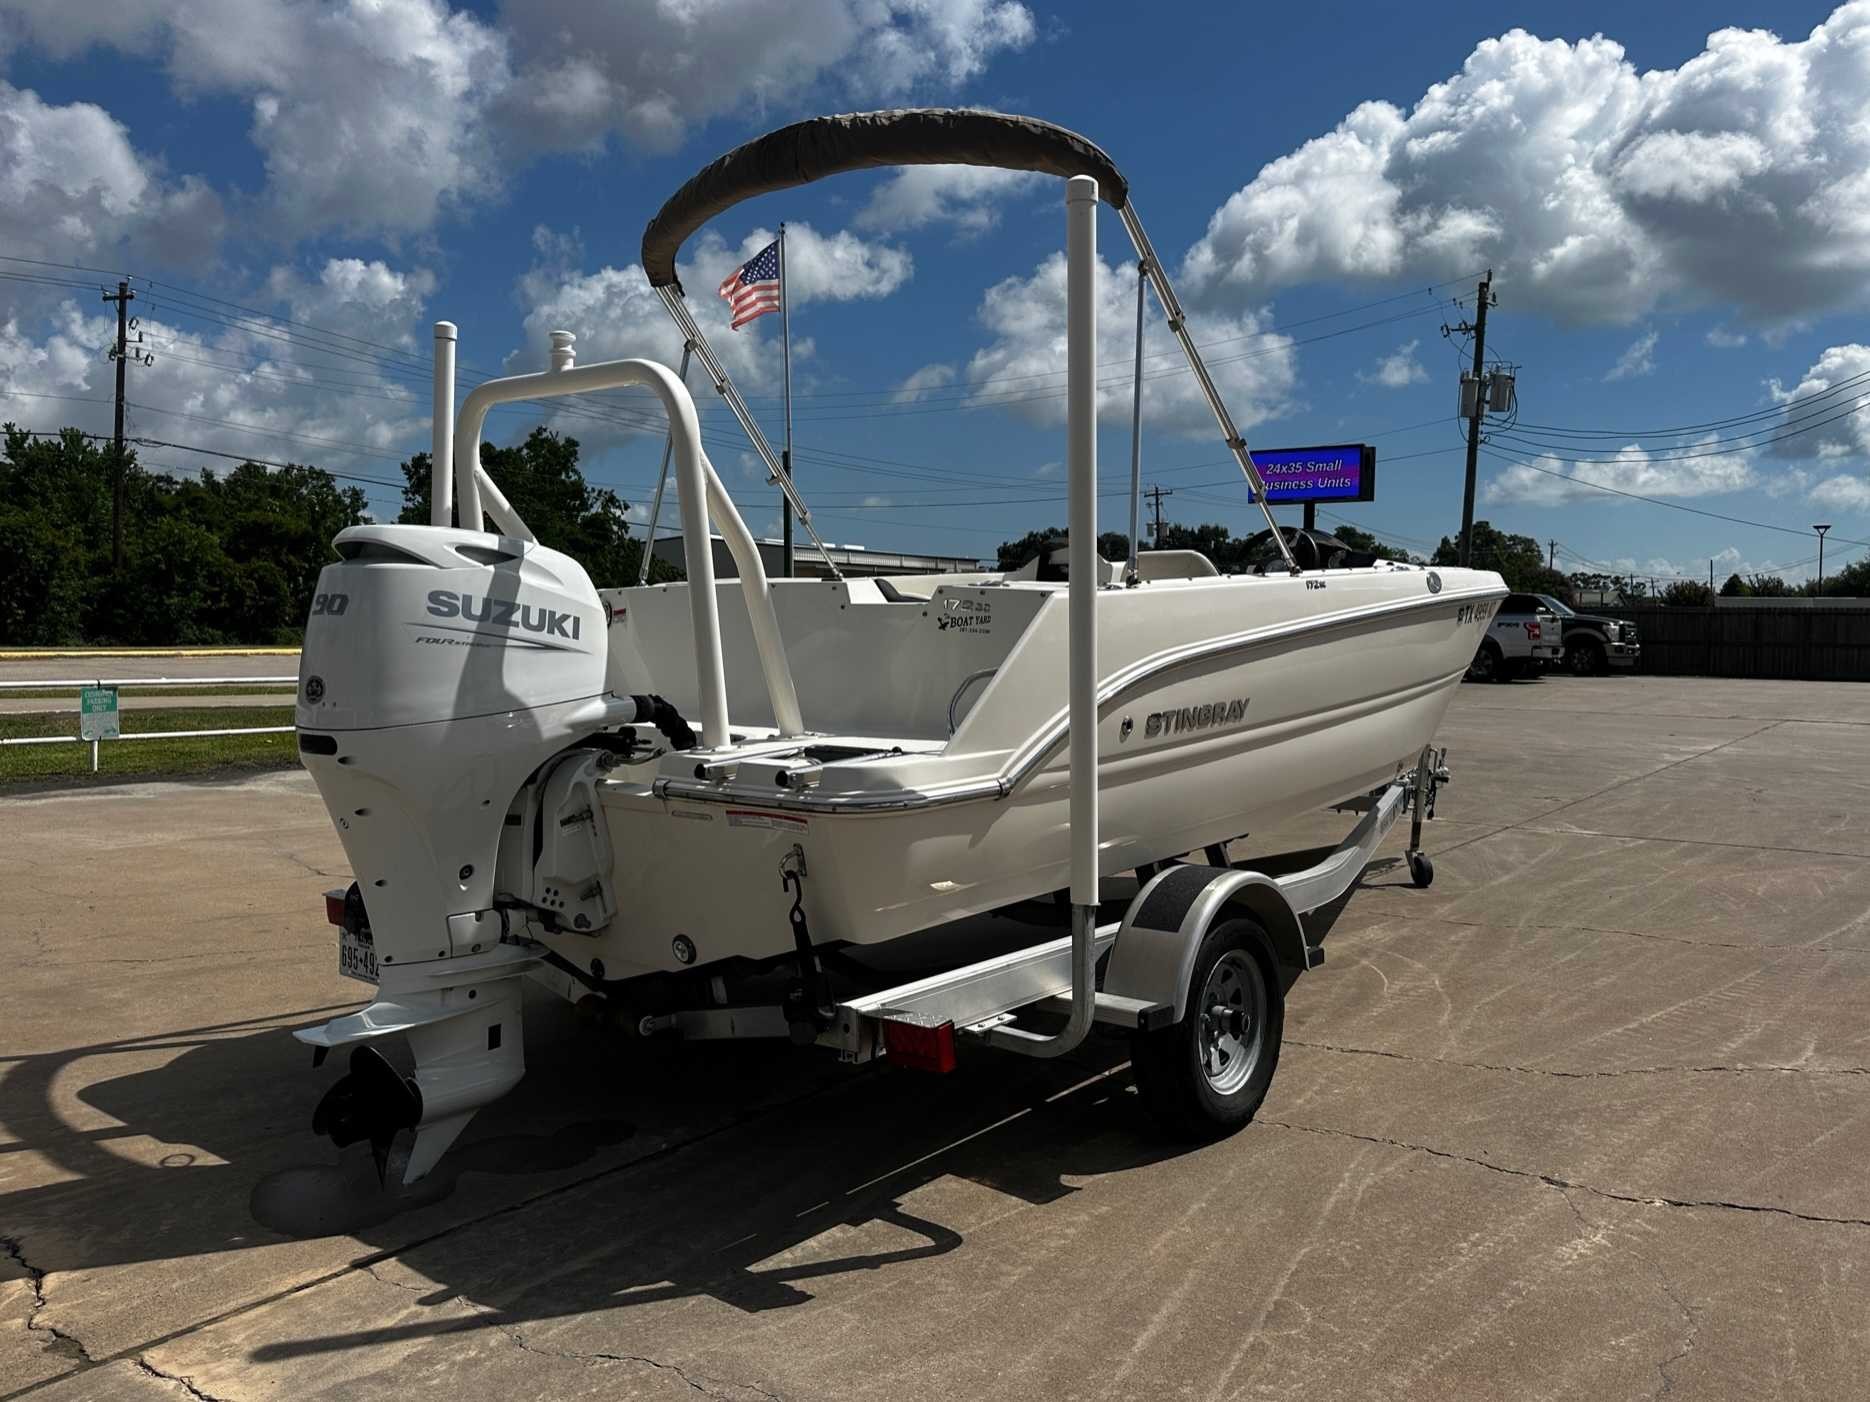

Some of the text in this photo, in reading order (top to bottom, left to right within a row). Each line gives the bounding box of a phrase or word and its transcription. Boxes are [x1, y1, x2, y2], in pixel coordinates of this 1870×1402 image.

[1266, 459, 1342, 475] 24x35 Small
[1264, 478, 1351, 490] usiness Units
[312, 593, 350, 616] 90
[426, 589, 581, 641] SUZUKI
[950, 616, 974, 628] BOAT
[975, 615, 991, 625] YARD
[1145, 698, 1250, 738] STINGRAY
